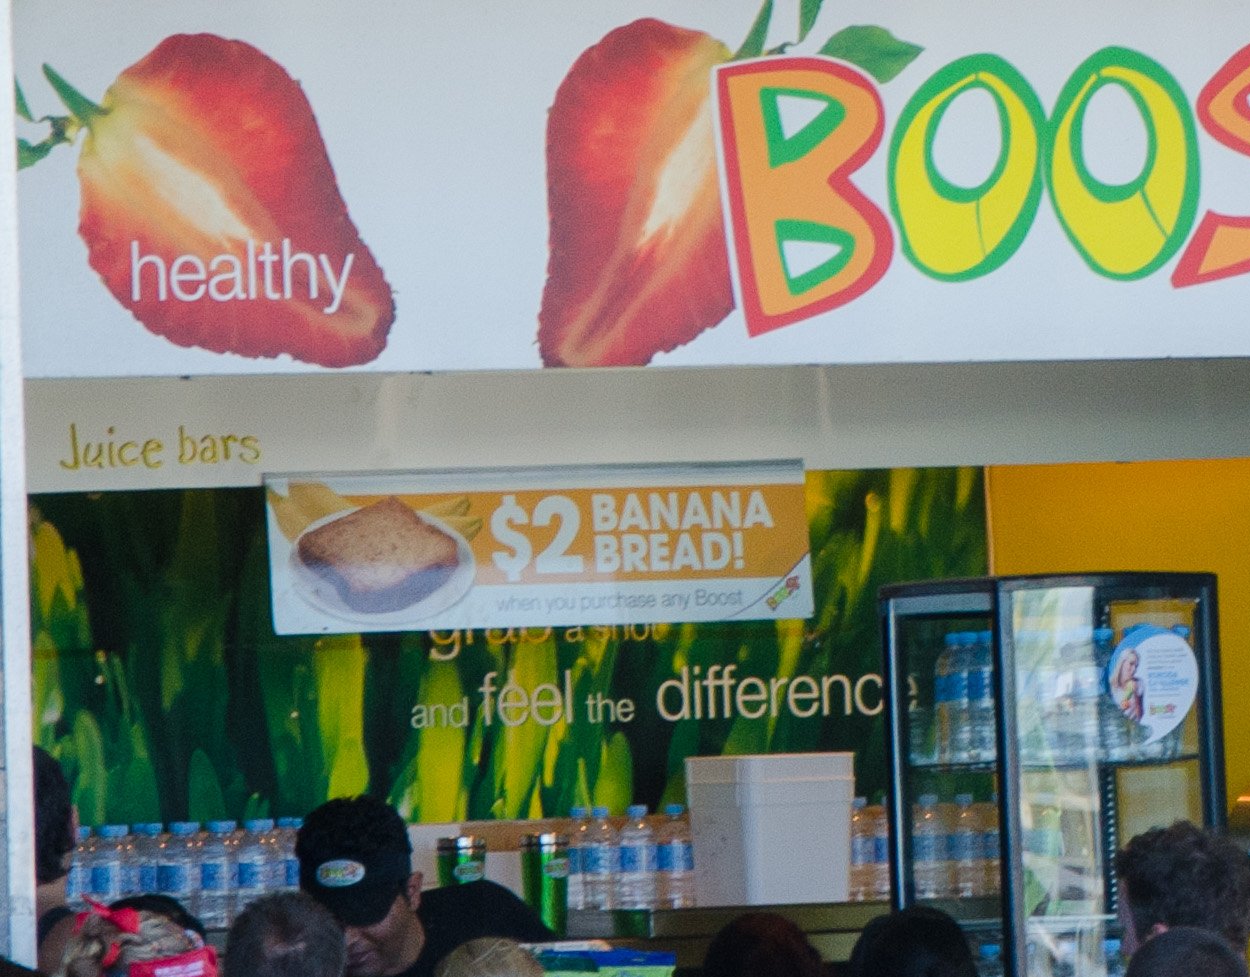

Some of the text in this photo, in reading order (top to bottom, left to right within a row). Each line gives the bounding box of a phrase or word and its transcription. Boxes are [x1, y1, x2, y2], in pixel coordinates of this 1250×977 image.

[130, 237, 354, 315] healthy
[59, 422, 261, 471] Juice bars
[592, 490, 774, 532] BANANA
[489, 493, 584, 582] $2
[592, 532, 746, 574] BREAD!
[498, 588, 743, 614] when you purchase any Boost
[411, 697, 469, 729] and
[478, 669, 573, 728] feel
[585, 693, 635, 724] the
